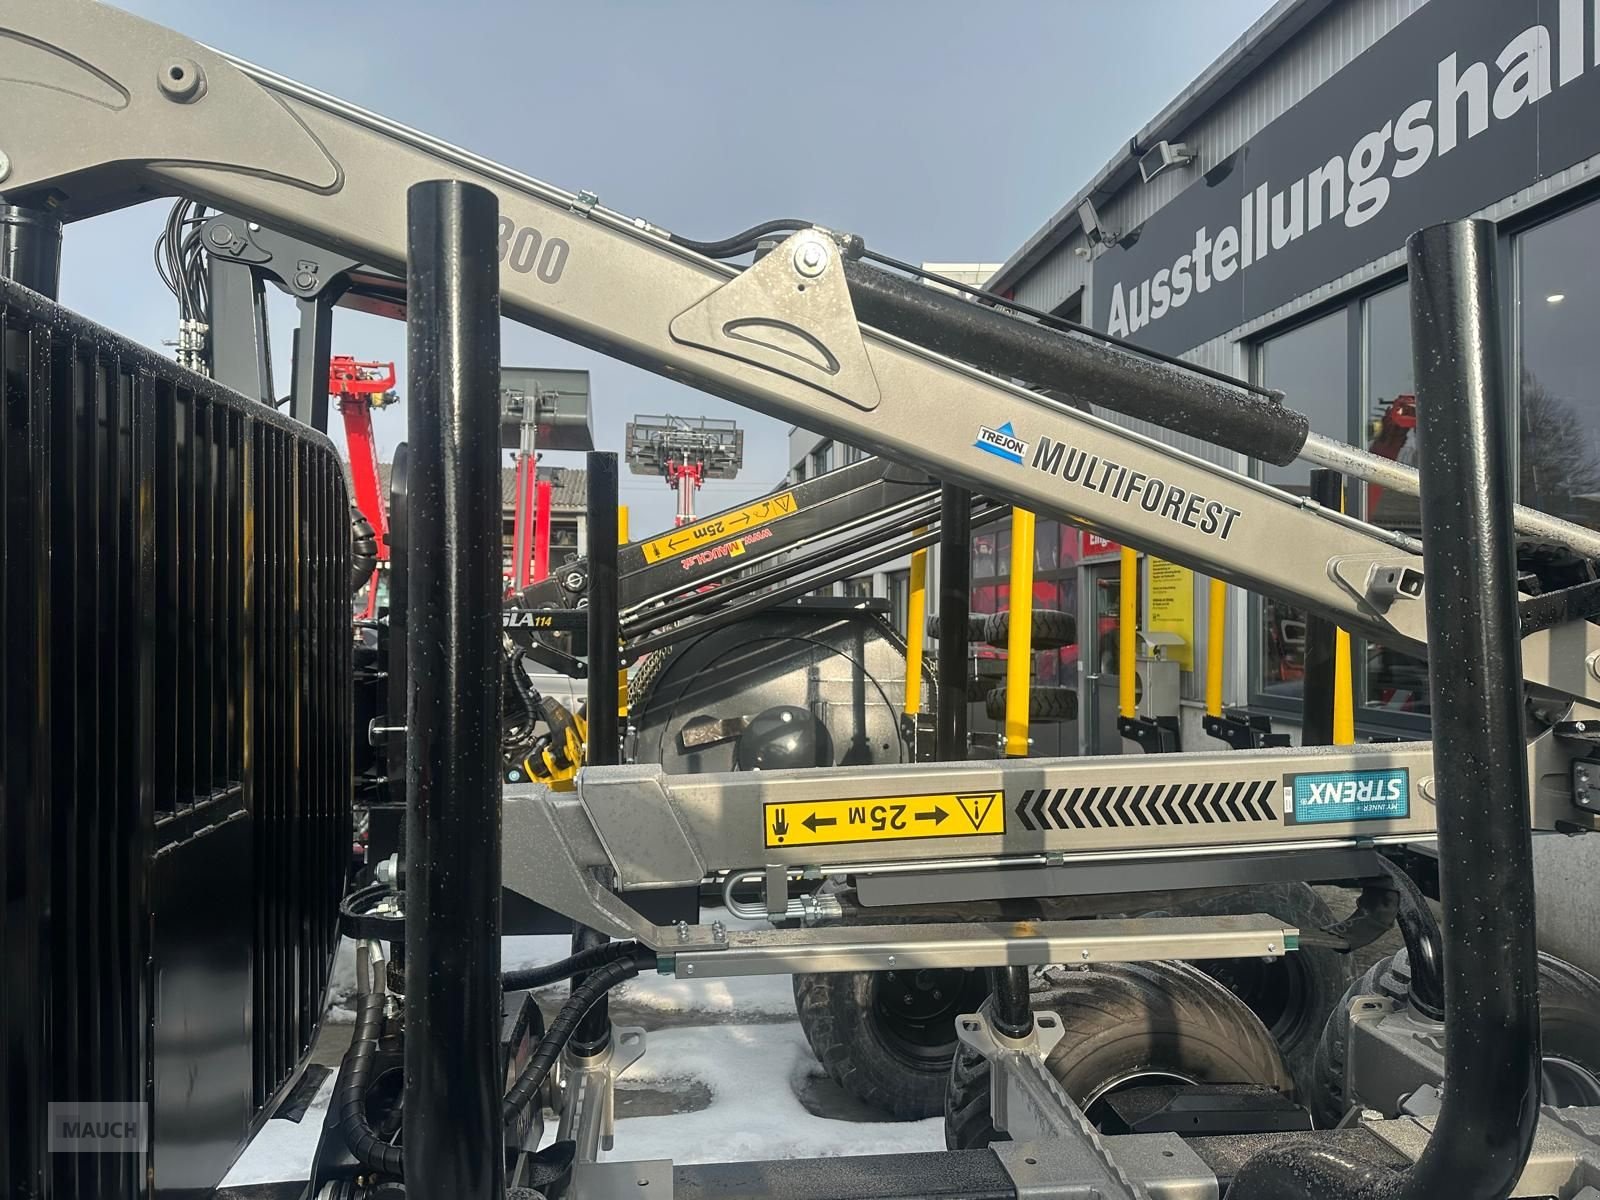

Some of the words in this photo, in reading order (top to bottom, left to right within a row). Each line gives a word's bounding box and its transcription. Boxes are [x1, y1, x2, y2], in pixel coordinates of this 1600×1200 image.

[1107, 0, 1600, 338] Ausstellungshal
[981, 428, 1025, 454] TREJON
[1031, 436, 1242, 541] MULTIFOREST
[693, 521, 725, 540] 25m
[535, 616, 552, 627] 114
[1363, 804, 1385, 812] INNER
